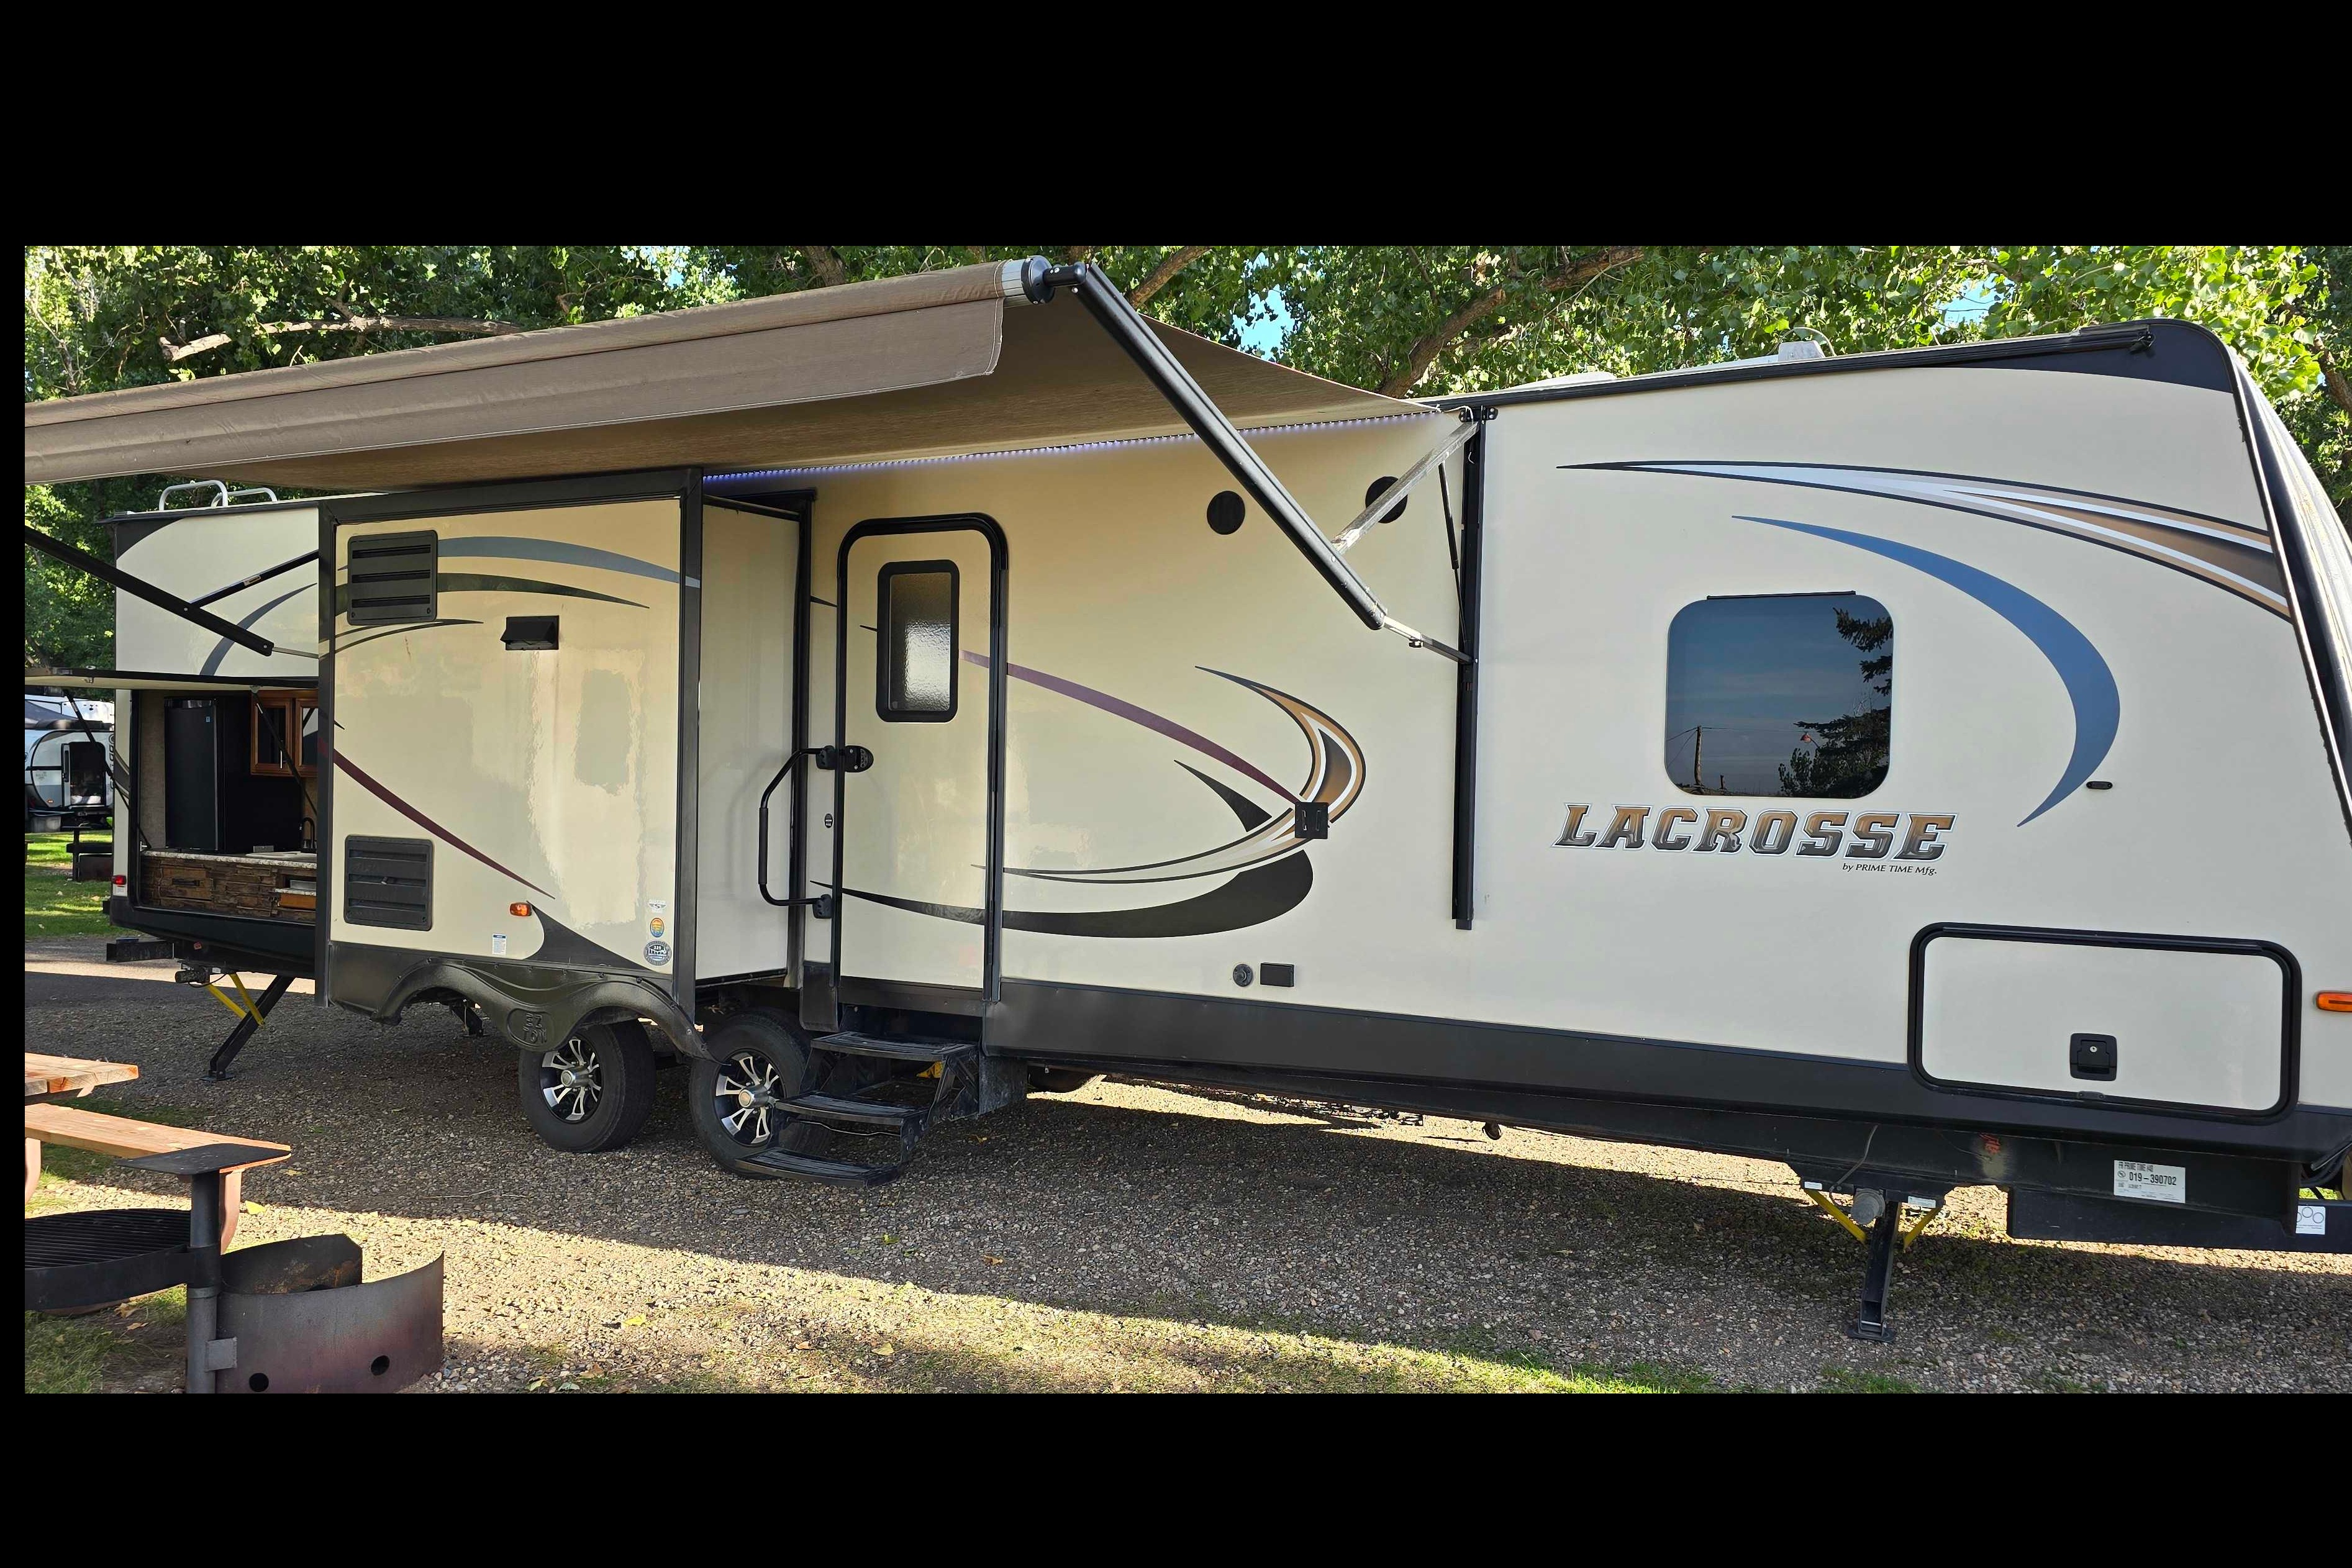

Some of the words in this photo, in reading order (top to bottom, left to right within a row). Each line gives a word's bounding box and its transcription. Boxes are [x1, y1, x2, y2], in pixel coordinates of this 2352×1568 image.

[1552, 802, 1958, 861] LACROSSE
[1842, 863, 1853, 872] by
[1856, 864, 1887, 872] PRIME
[1889, 865, 1914, 873] TIME
[1915, 866, 1937, 876] Mfg.
